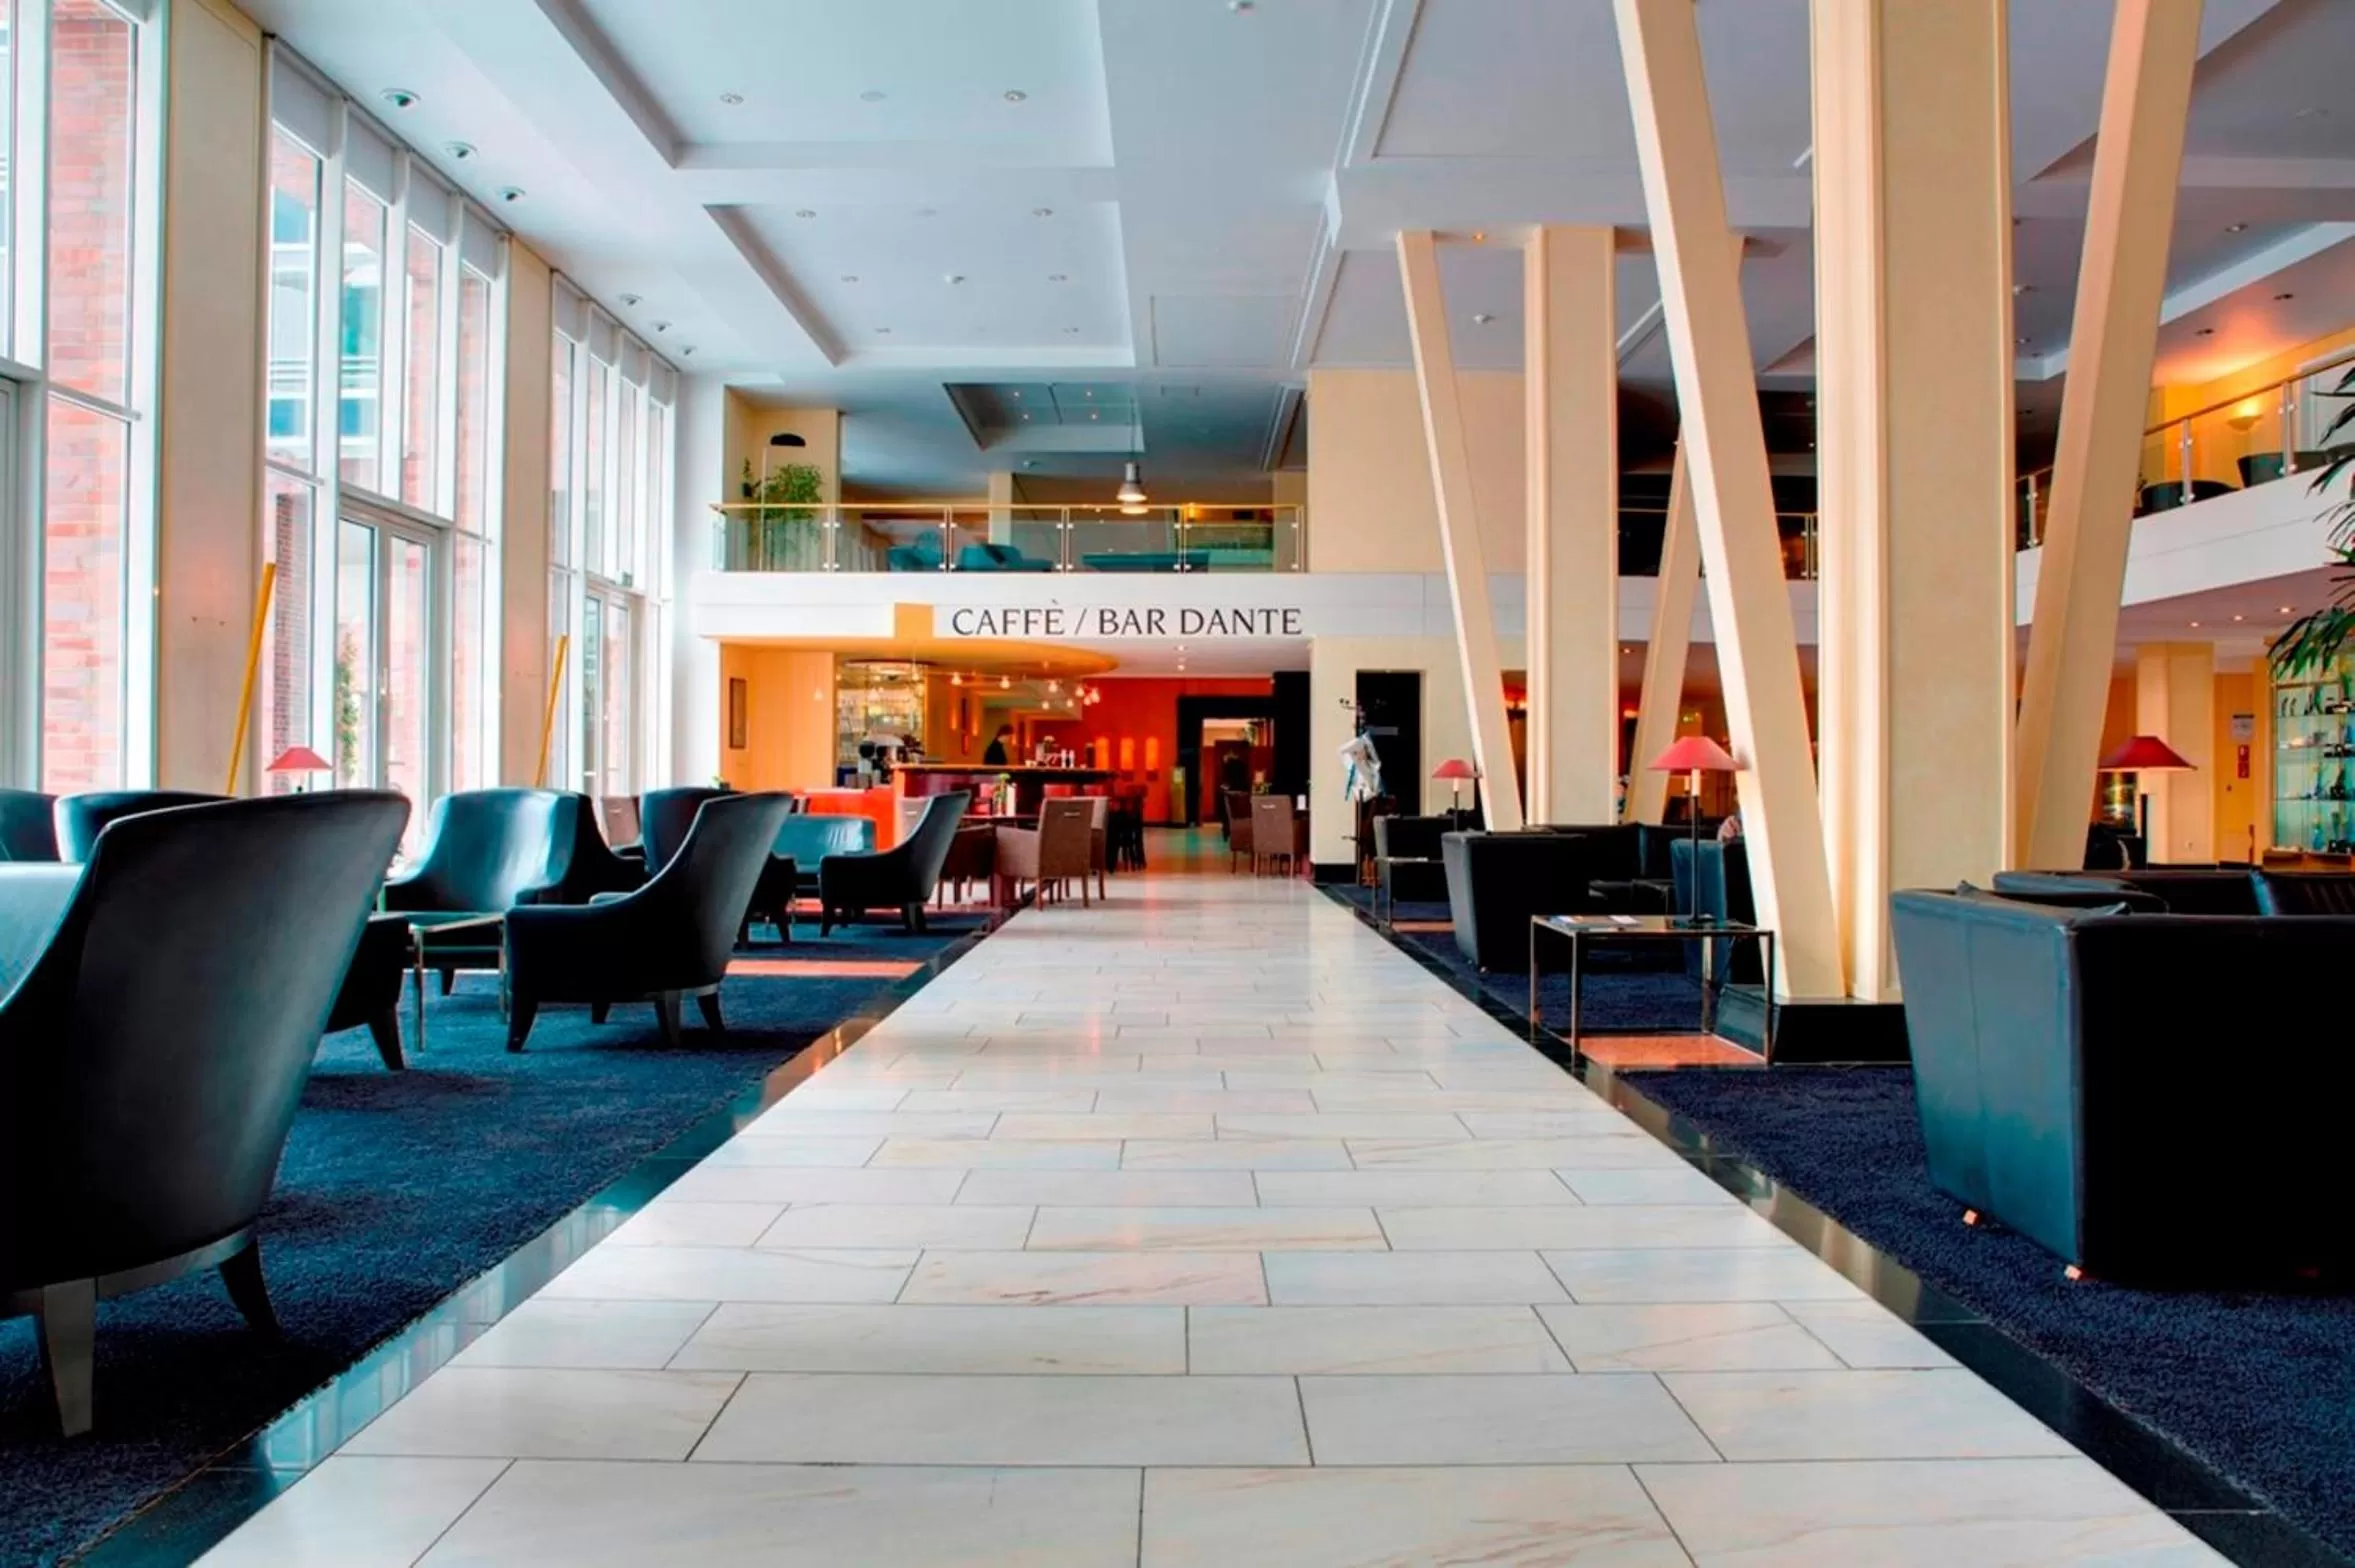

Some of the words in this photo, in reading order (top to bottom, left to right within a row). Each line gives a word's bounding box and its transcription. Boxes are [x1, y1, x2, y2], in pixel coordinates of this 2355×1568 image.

[952, 599, 1065, 636] CAFFÈ
[1075, 609, 1087, 637] /
[1099, 608, 1166, 635] BAR
[1181, 608, 1302, 635] DANTE
